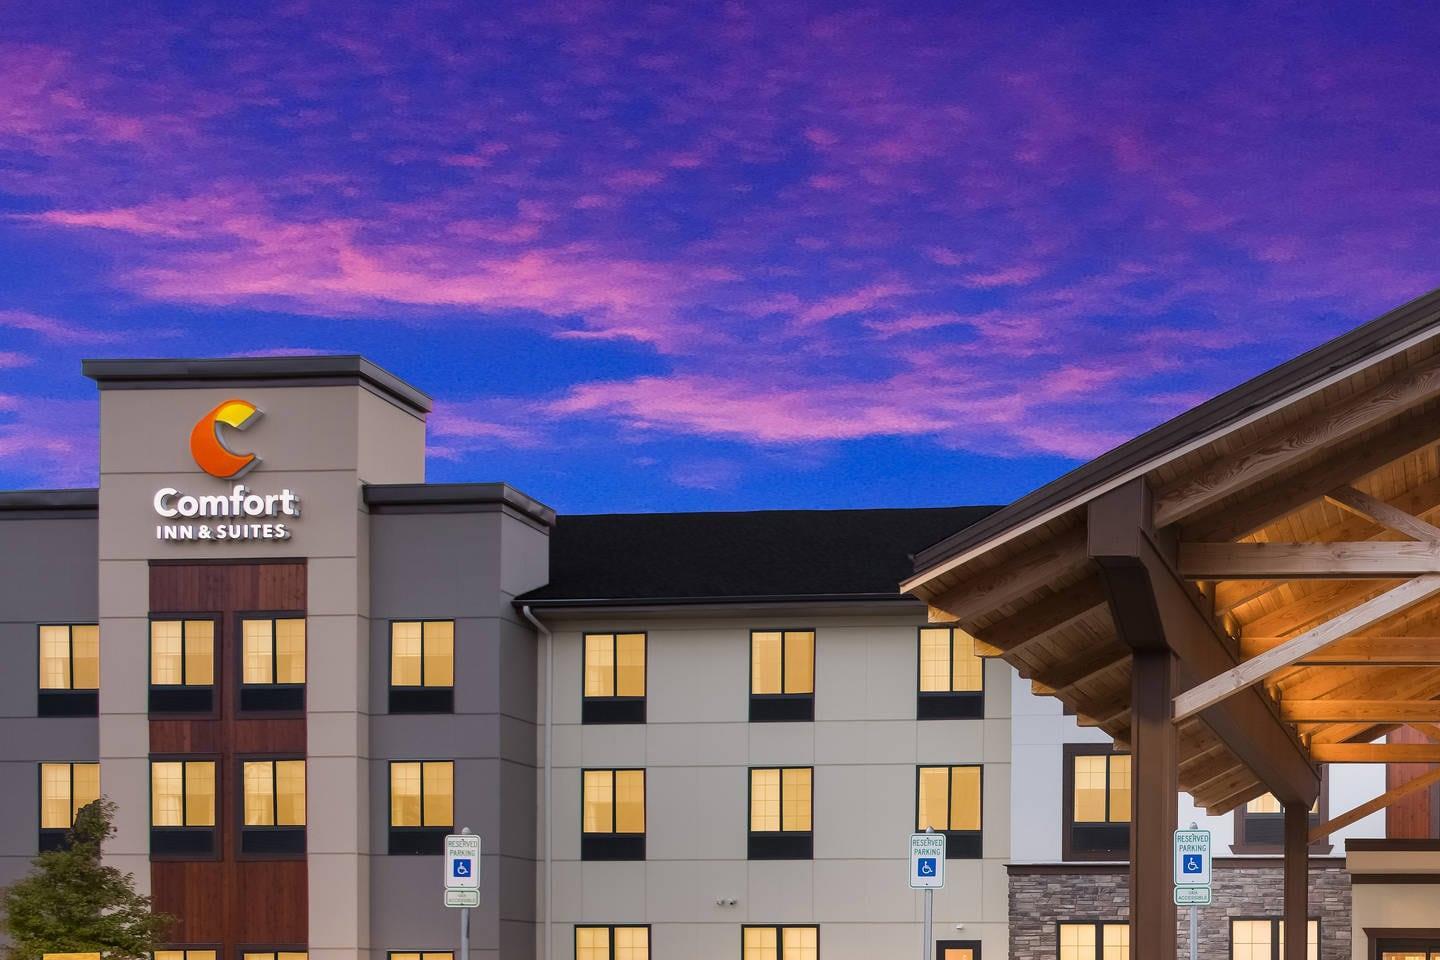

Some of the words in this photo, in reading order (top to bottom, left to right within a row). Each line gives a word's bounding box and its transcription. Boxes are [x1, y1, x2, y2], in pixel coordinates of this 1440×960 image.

[153, 484, 297, 517] Comfort
[156, 524, 193, 540] INN
[198, 524, 212, 540] &
[216, 523, 287, 540] SUITES
